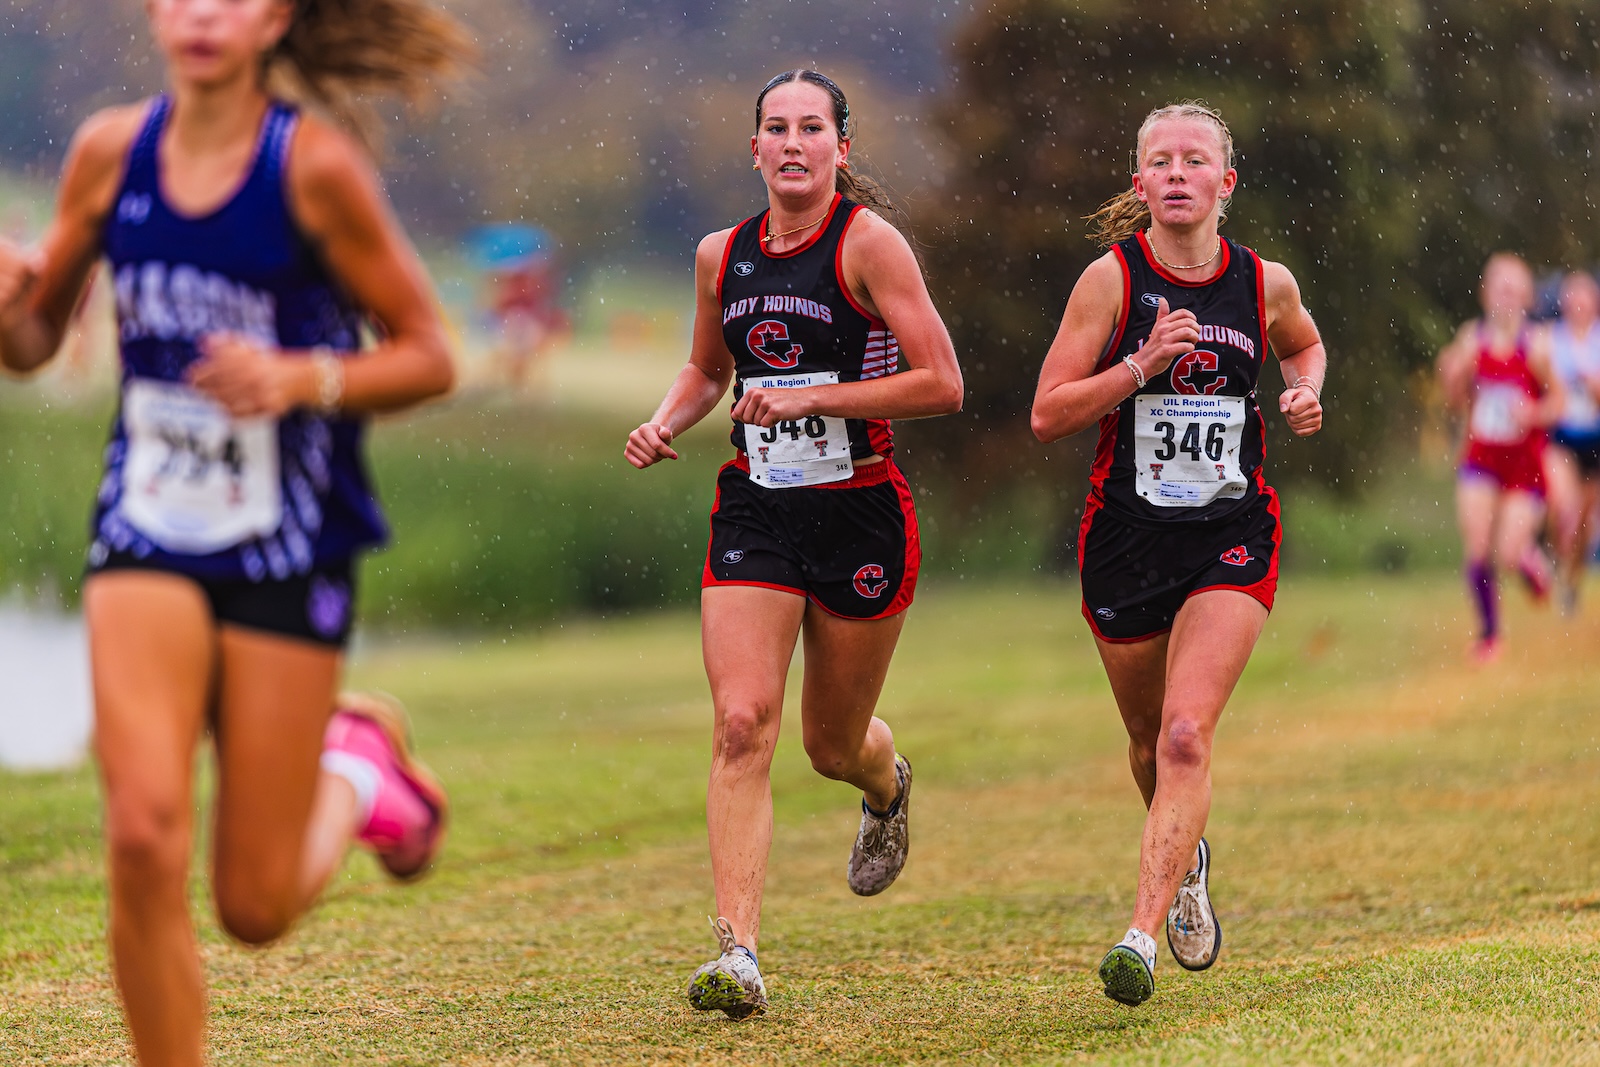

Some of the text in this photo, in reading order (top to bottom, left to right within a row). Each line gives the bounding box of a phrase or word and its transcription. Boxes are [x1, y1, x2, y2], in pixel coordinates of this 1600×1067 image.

[723, 295, 833, 326] LADY HOUNDS
[762, 380, 775, 388] UIL
[777, 379, 806, 388] Region
[1163, 398, 1180, 406] UIL
[1182, 399, 1215, 408] Region
[1150, 408, 1231, 418] XC Championship
[1154, 421, 1226, 461] 346
